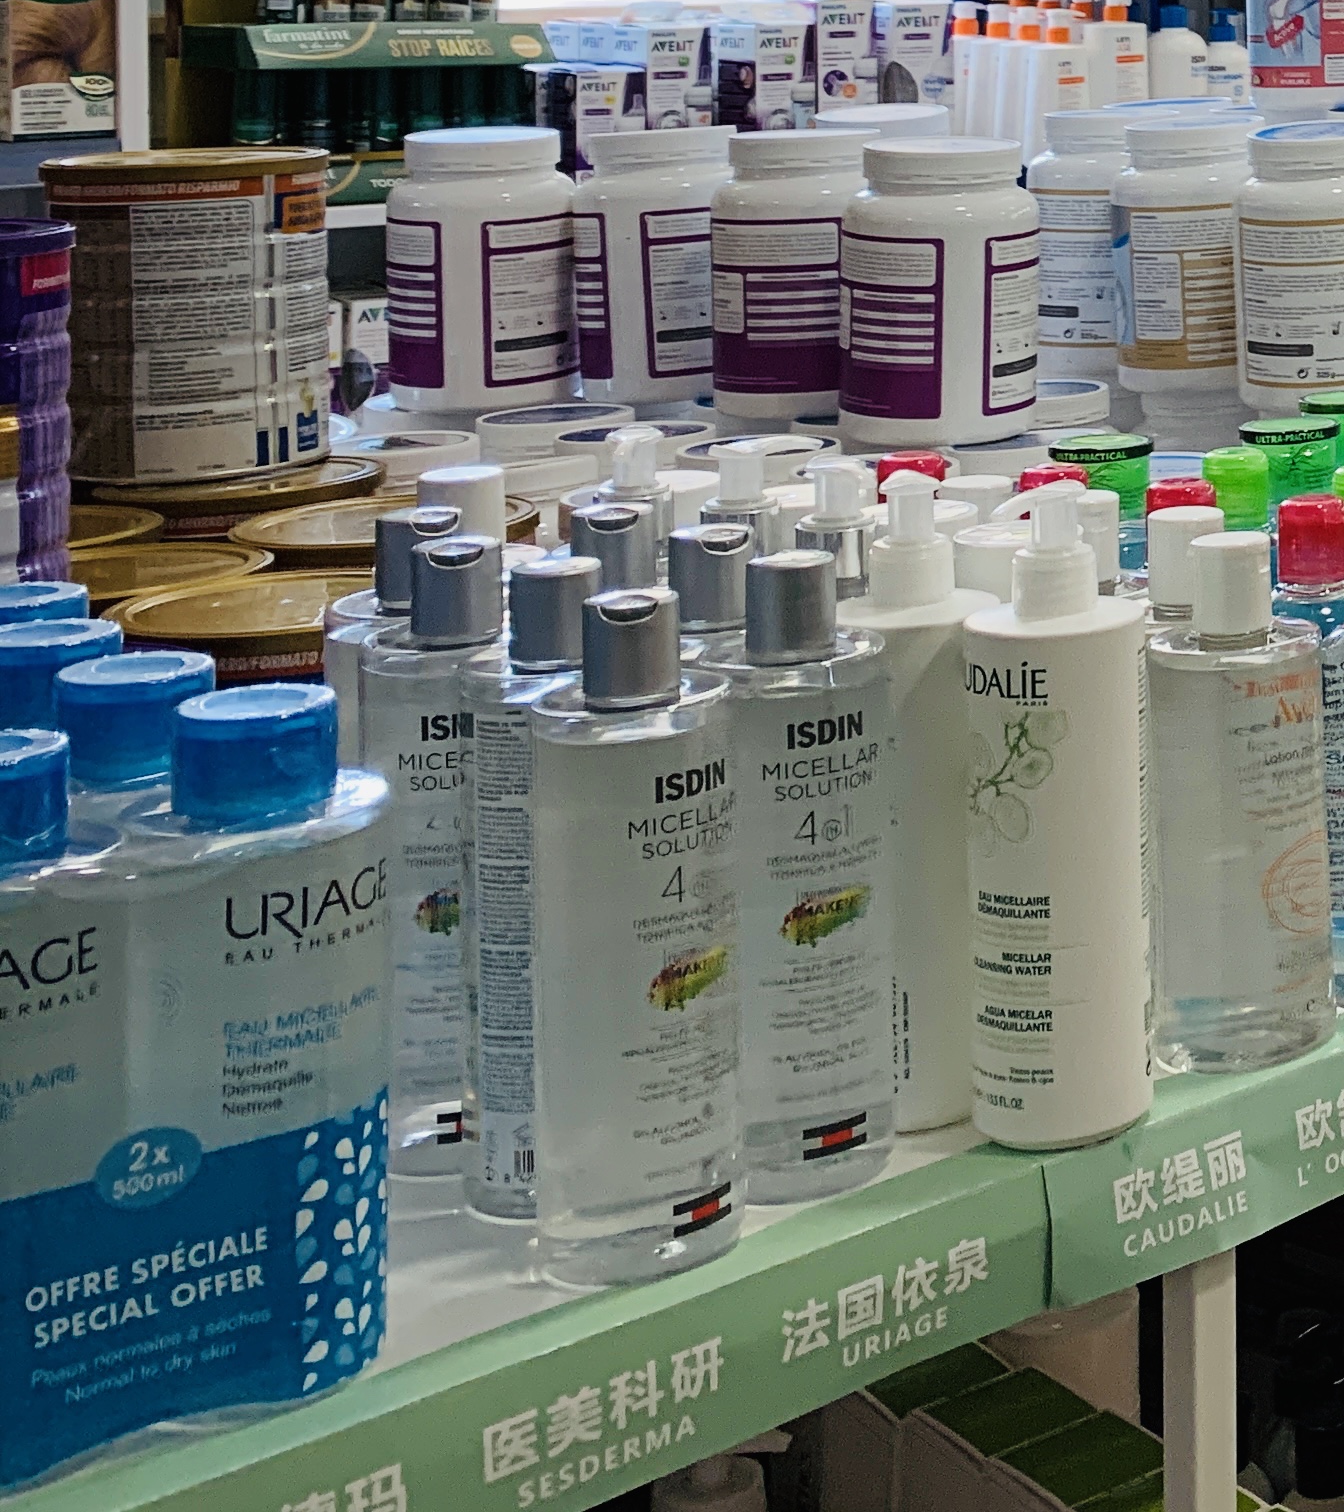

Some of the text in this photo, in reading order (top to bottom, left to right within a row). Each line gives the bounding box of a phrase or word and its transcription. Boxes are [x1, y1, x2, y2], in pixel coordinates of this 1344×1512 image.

[895, 14, 942, 29] AVENT
[761, 741, 879, 783] MICELLAR
[787, 710, 865, 751] ISDIN
[654, 757, 727, 805] ISDIN
[795, 810, 817, 846] 4
[224, 857, 388, 941] URIAGE
[1015, 963, 1053, 976] WATER
[129, 1141, 170, 1171] 2x
[1112, 1129, 1249, 1226] 欧缇丽
[1121, 1190, 1250, 1260] CAUDALIE
[25, 1225, 269, 1313] OFFRE SPÉCIALE
[780, 1236, 990, 1364] 法国依泉
[33, 1263, 266, 1351] SPECIAL OFFER
[842, 1305, 950, 1368] URIAGE
[481, 1336, 725, 1484] 医美科研
[516, 1417, 698, 1509] SESDERMA
